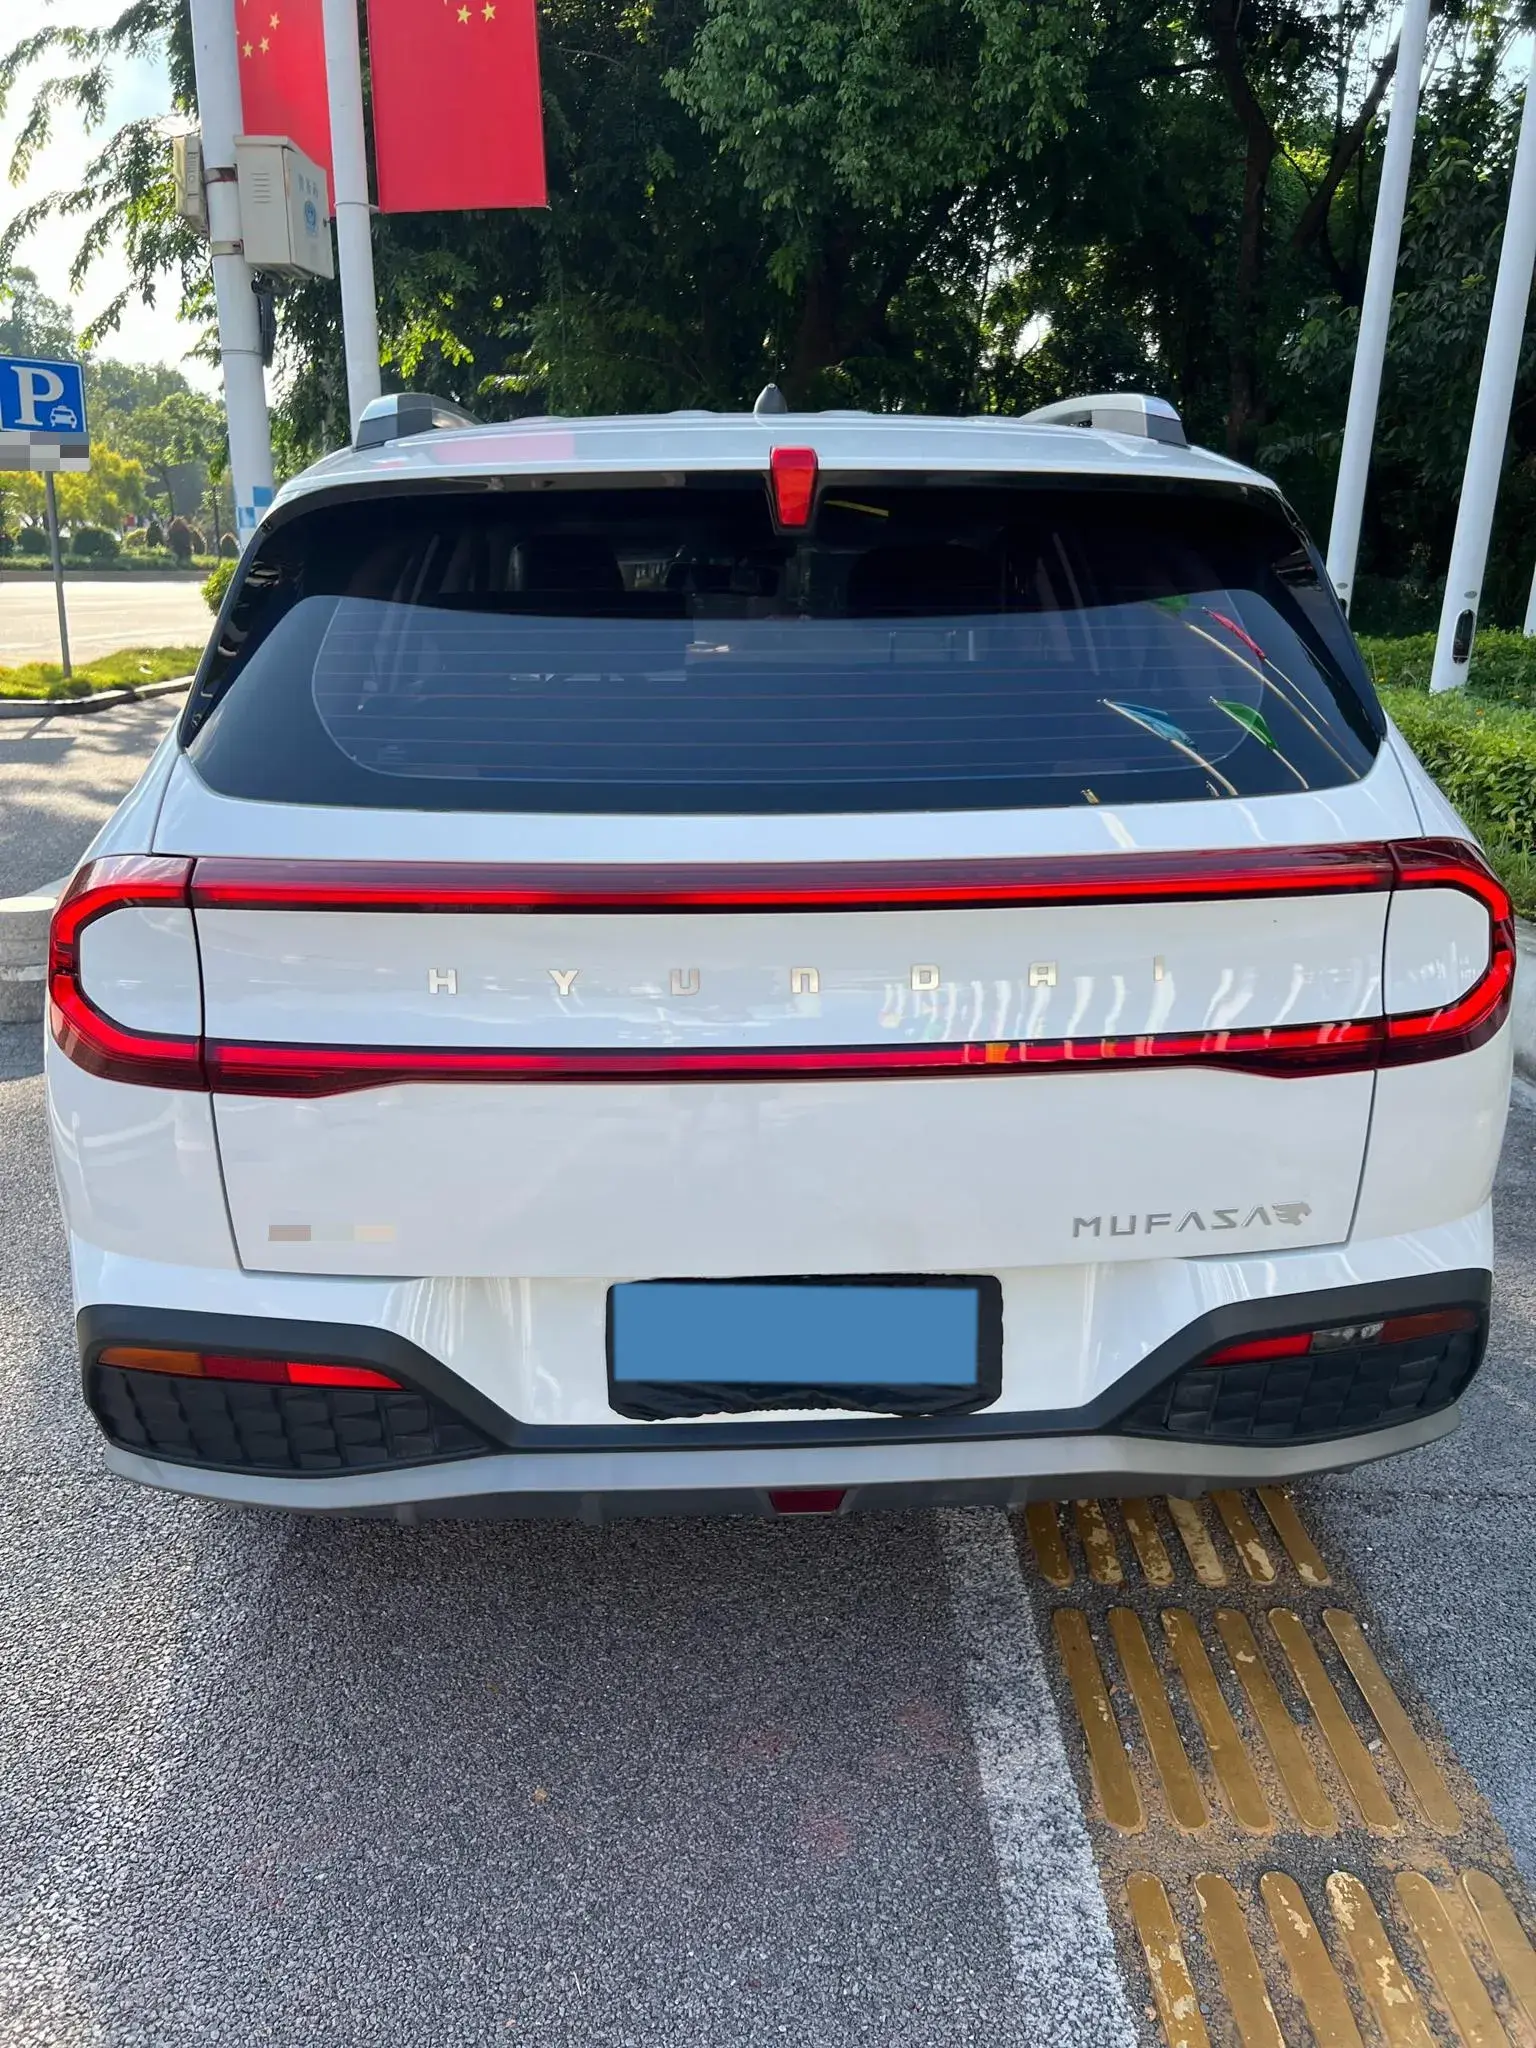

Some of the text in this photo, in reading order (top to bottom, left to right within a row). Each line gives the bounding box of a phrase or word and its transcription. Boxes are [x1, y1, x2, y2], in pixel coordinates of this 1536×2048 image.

[10, 365, 64, 426] P
[428, 956, 1164, 996] HYUNDAI
[1072, 1206, 1272, 1238] MUFASA
